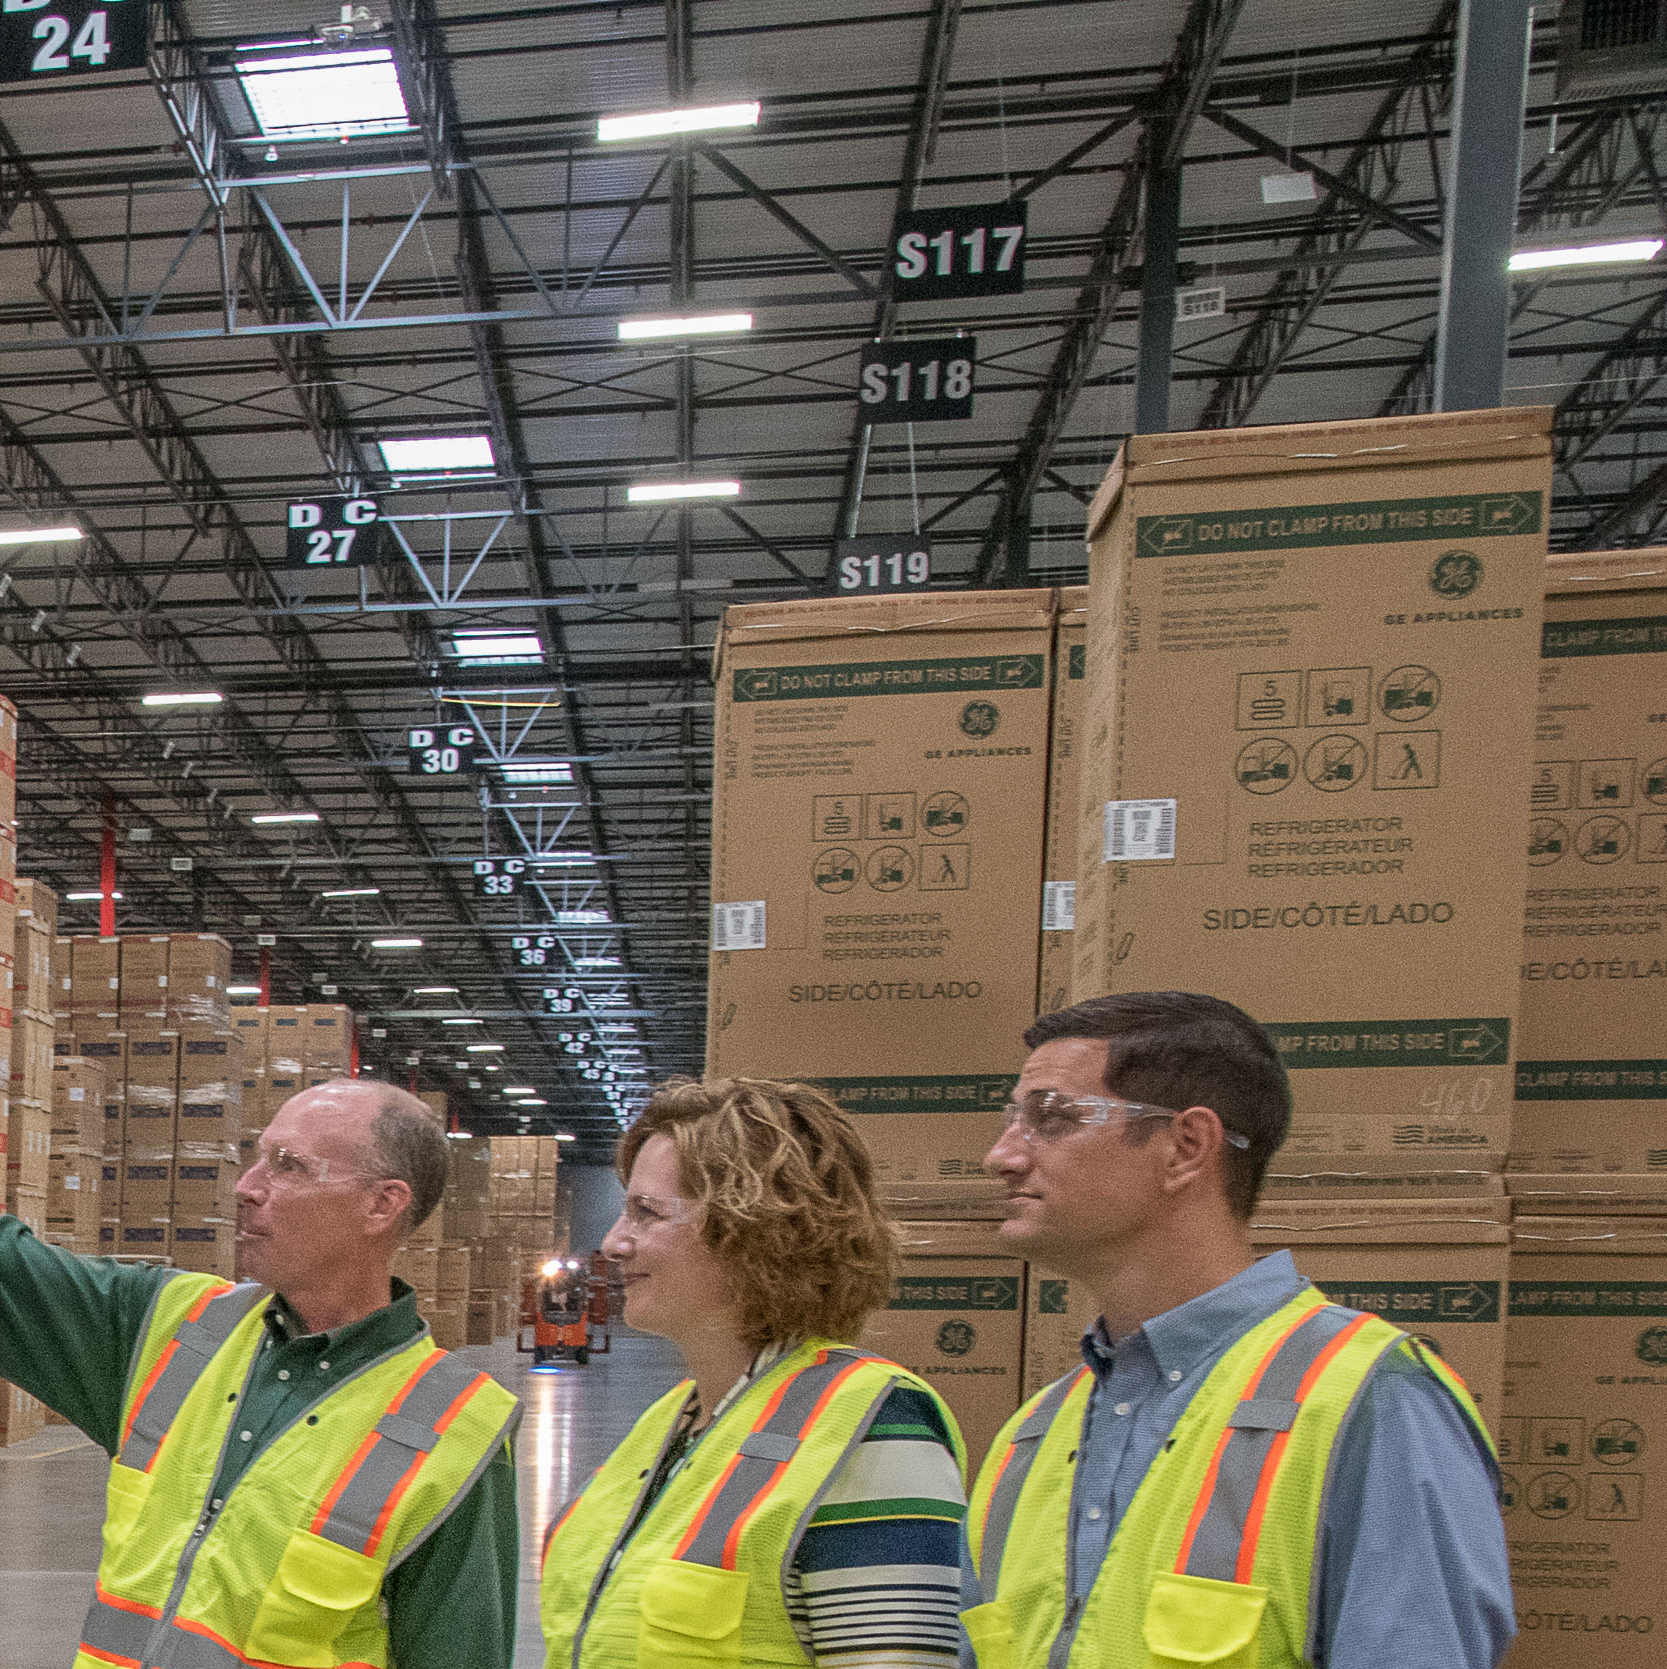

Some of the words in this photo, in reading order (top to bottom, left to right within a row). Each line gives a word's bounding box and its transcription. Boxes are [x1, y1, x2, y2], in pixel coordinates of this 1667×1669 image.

[31, 10, 111, 72] 24
[895, 226, 1025, 280] S117
[860, 357, 972, 404] S118
[290, 503, 320, 528] D
[345, 500, 378, 526] C
[1197, 522, 1225, 542] DO
[1227, 520, 1264, 540] NOT
[1267, 515, 1328, 538] CLAMP
[1330, 512, 1385, 533] FROM
[1388, 509, 1427, 529] THIS
[1431, 506, 1473, 526] SIDE
[306, 530, 354, 565] 27
[839, 551, 930, 590] S119
[1384, 613, 1407, 626] GE
[1413, 607, 1524, 623] APPLIANCES
[780, 674, 801, 690] DO
[805, 673, 834, 688] NOT
[836, 671, 882, 687] CLAMP
[884, 669, 923, 684] FROM
[925, 668, 957, 683] THIS
[959, 666, 992, 682] SIDE
[409, 730, 435, 748] D
[448, 728, 474, 746] C
[422, 748, 459, 773] 30
[924, 749, 942, 759] GE
[947, 746, 1032, 758] APPLIANCES
[1250, 816, 1403, 836] REFRIGERATOR
[474, 860, 495, 875] D
[504, 859, 525, 874] C
[1248, 859, 1404, 878] REFRIGERADOR
[484, 875, 514, 895] 33
[822, 912, 942, 927] REFRIGERATOR
[512, 937, 530, 949] D
[537, 936, 555, 948] C
[520, 949, 546, 966] 36
[543, 988, 559, 999] D
[564, 987, 580, 998] C
[550, 999, 573, 1013] 39
[1308, 1034, 1356, 1051] FROM
[1361, 1033, 1401, 1050] THIS
[1404, 1032, 1445, 1050] SIDE
[926, 1365, 1007, 1377] APPLIANCES
